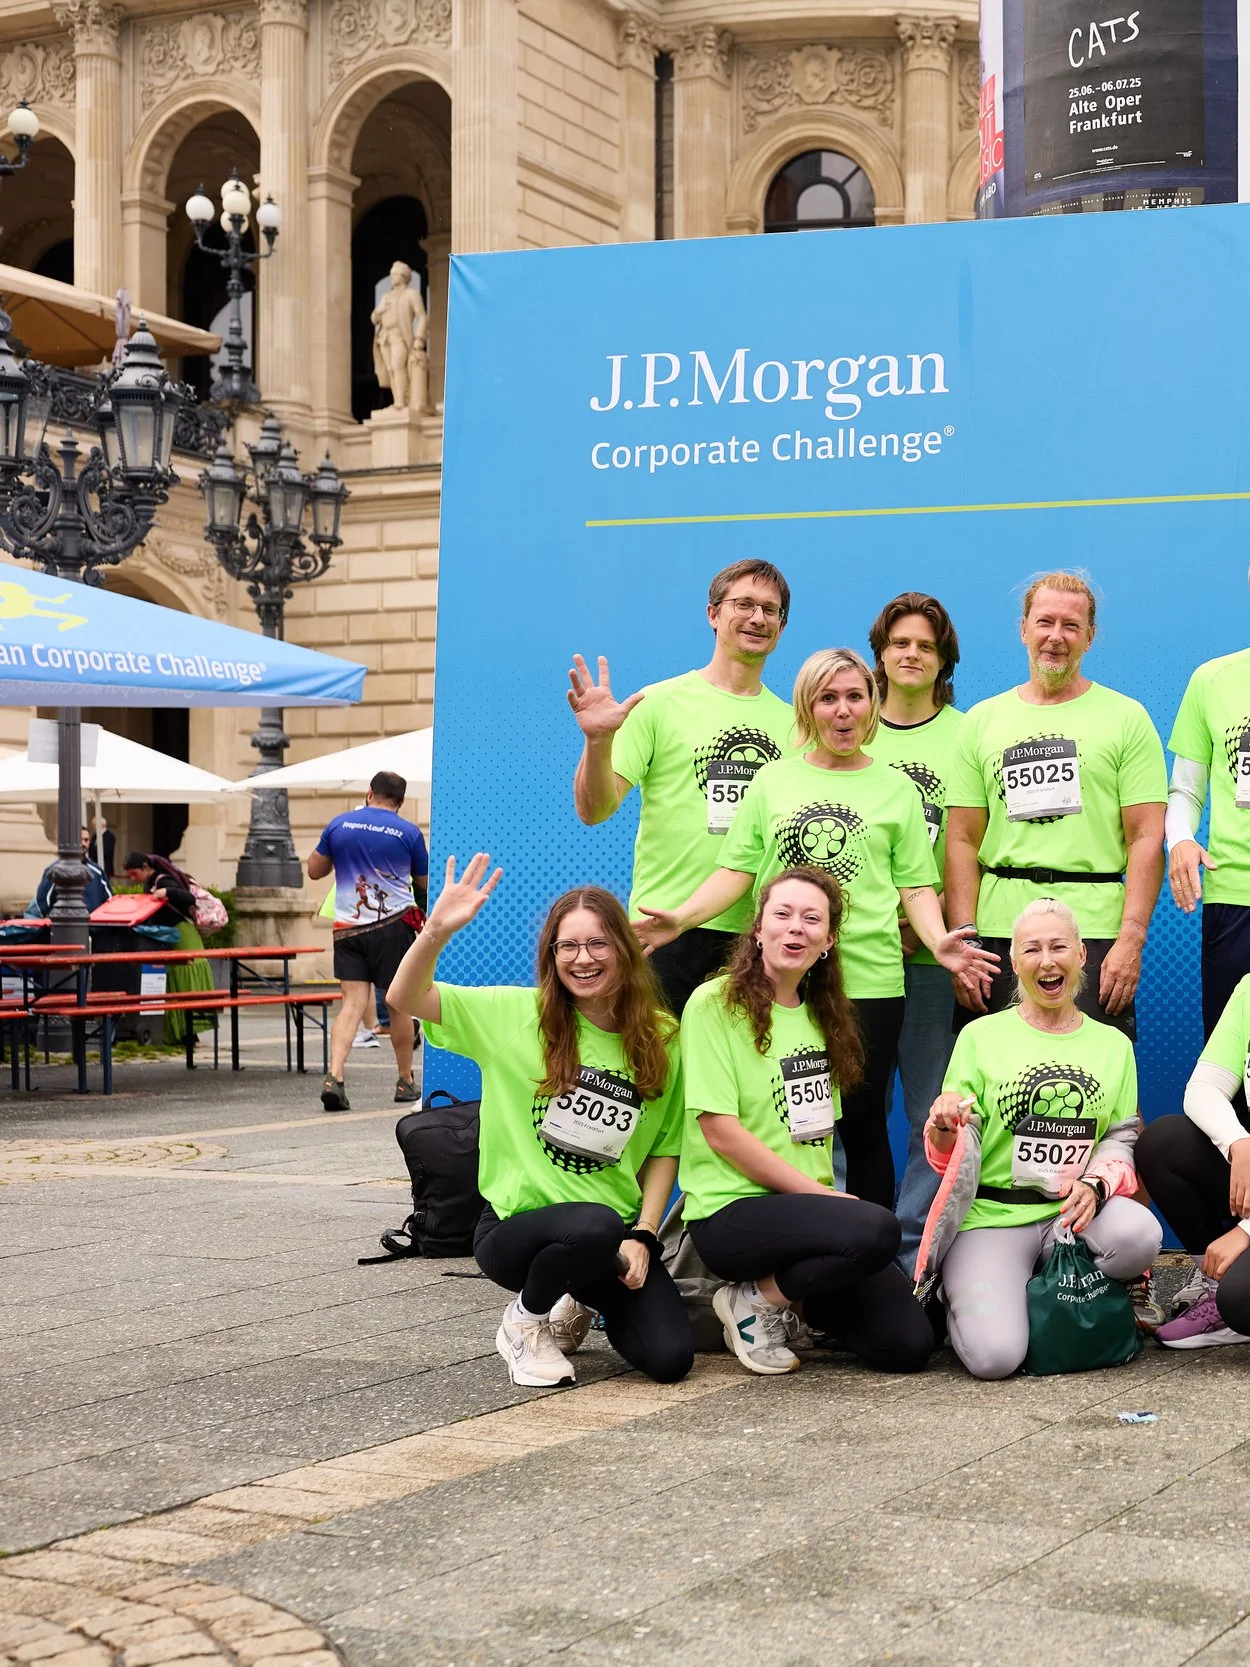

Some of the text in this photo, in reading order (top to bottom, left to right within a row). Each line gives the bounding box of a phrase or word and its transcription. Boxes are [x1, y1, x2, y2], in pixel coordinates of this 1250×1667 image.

[1069, 11, 1140, 68] CATS
[1069, 94, 1142, 116] Alte Oper
[1069, 111, 1142, 134] Frankfurt
[1143, 198, 1192, 206] MEMPHIS
[590, 348, 949, 421] J.P.Morgan
[591, 436, 760, 473] Corporate
[32, 643, 152, 675] Corporate
[1007, 762, 1074, 789] 55025
[791, 1078, 831, 1106] 5503
[557, 1090, 633, 1131] 55033
[1017, 1141, 1090, 1165] 55027
